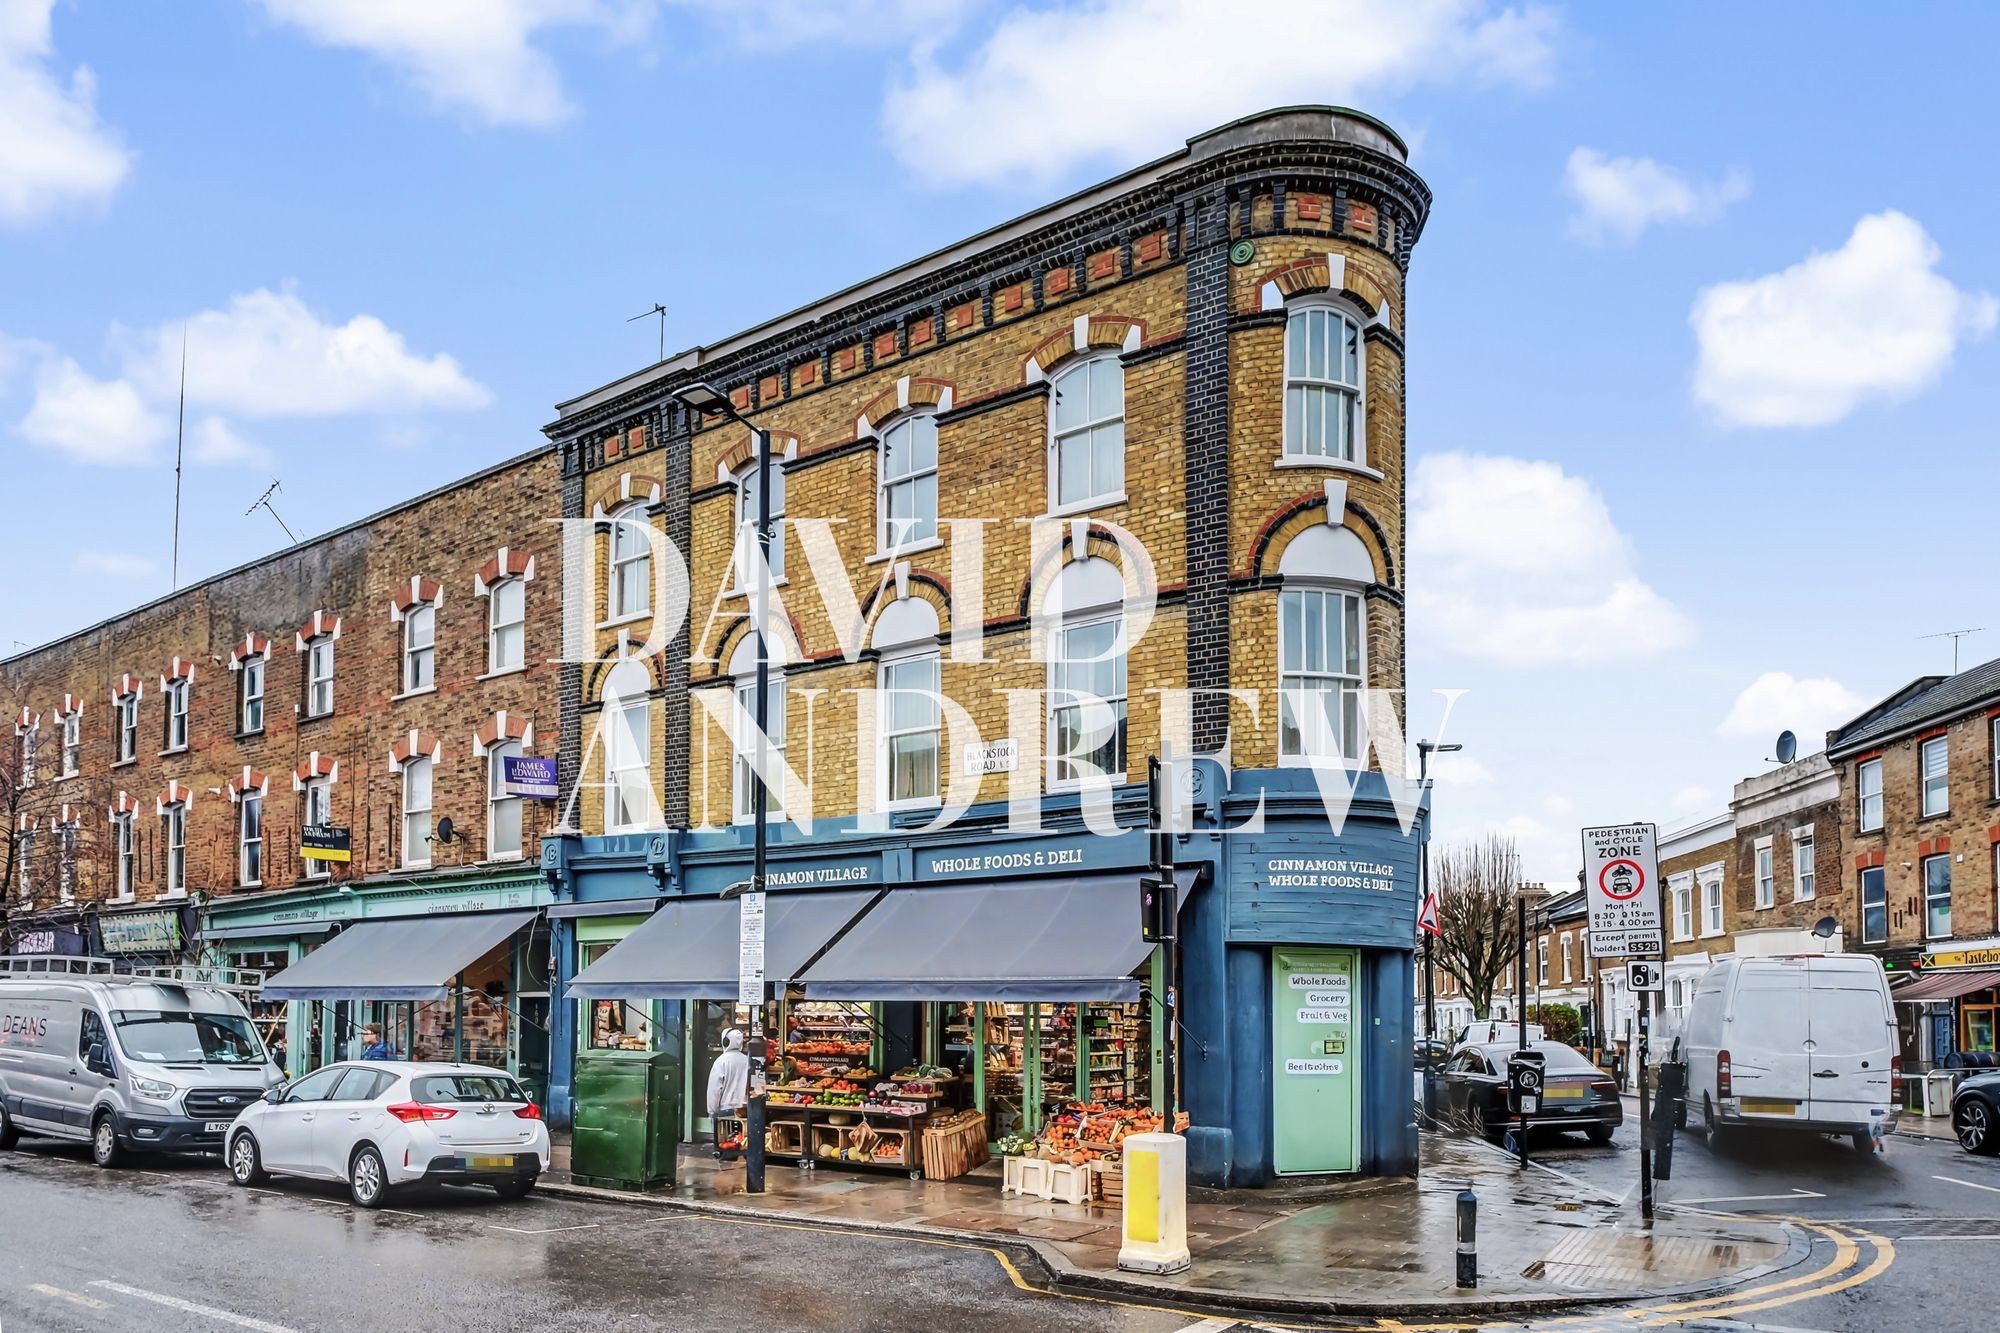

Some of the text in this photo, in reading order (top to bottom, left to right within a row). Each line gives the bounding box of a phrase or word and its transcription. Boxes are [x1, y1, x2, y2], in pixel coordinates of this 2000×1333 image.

[971, 760, 996, 772] ROAD
[1588, 827, 1649, 838] PEDESTRIAN
[1612, 835, 1644, 845] CYCLE
[1598, 845, 1642, 858] ZONE
[931, 848, 1083, 873] WHOLE FOODS & DELI
[1268, 859, 1394, 876] CINNAMON VILLAGE
[816, 866, 868, 882] VILLAGE
[1268, 875, 1394, 892] WHOLE FOODS & DELI
[1605, 903, 1624, 911] Mon
[1630, 901, 1643, 909] Fri
[1595, 932, 1657, 942] Except permit
[1593, 942, 1659, 953] holders SS29
[1962, 949, 2000, 965] Tastebo
[1291, 976, 1347, 986] Whole Foods
[1309, 994, 1346, 1004] Grocery
[1300, 1011, 1323, 1020] Fruit
[1332, 1011, 1348, 1022] Veg
[3, 1015, 48, 1037] DEANS
